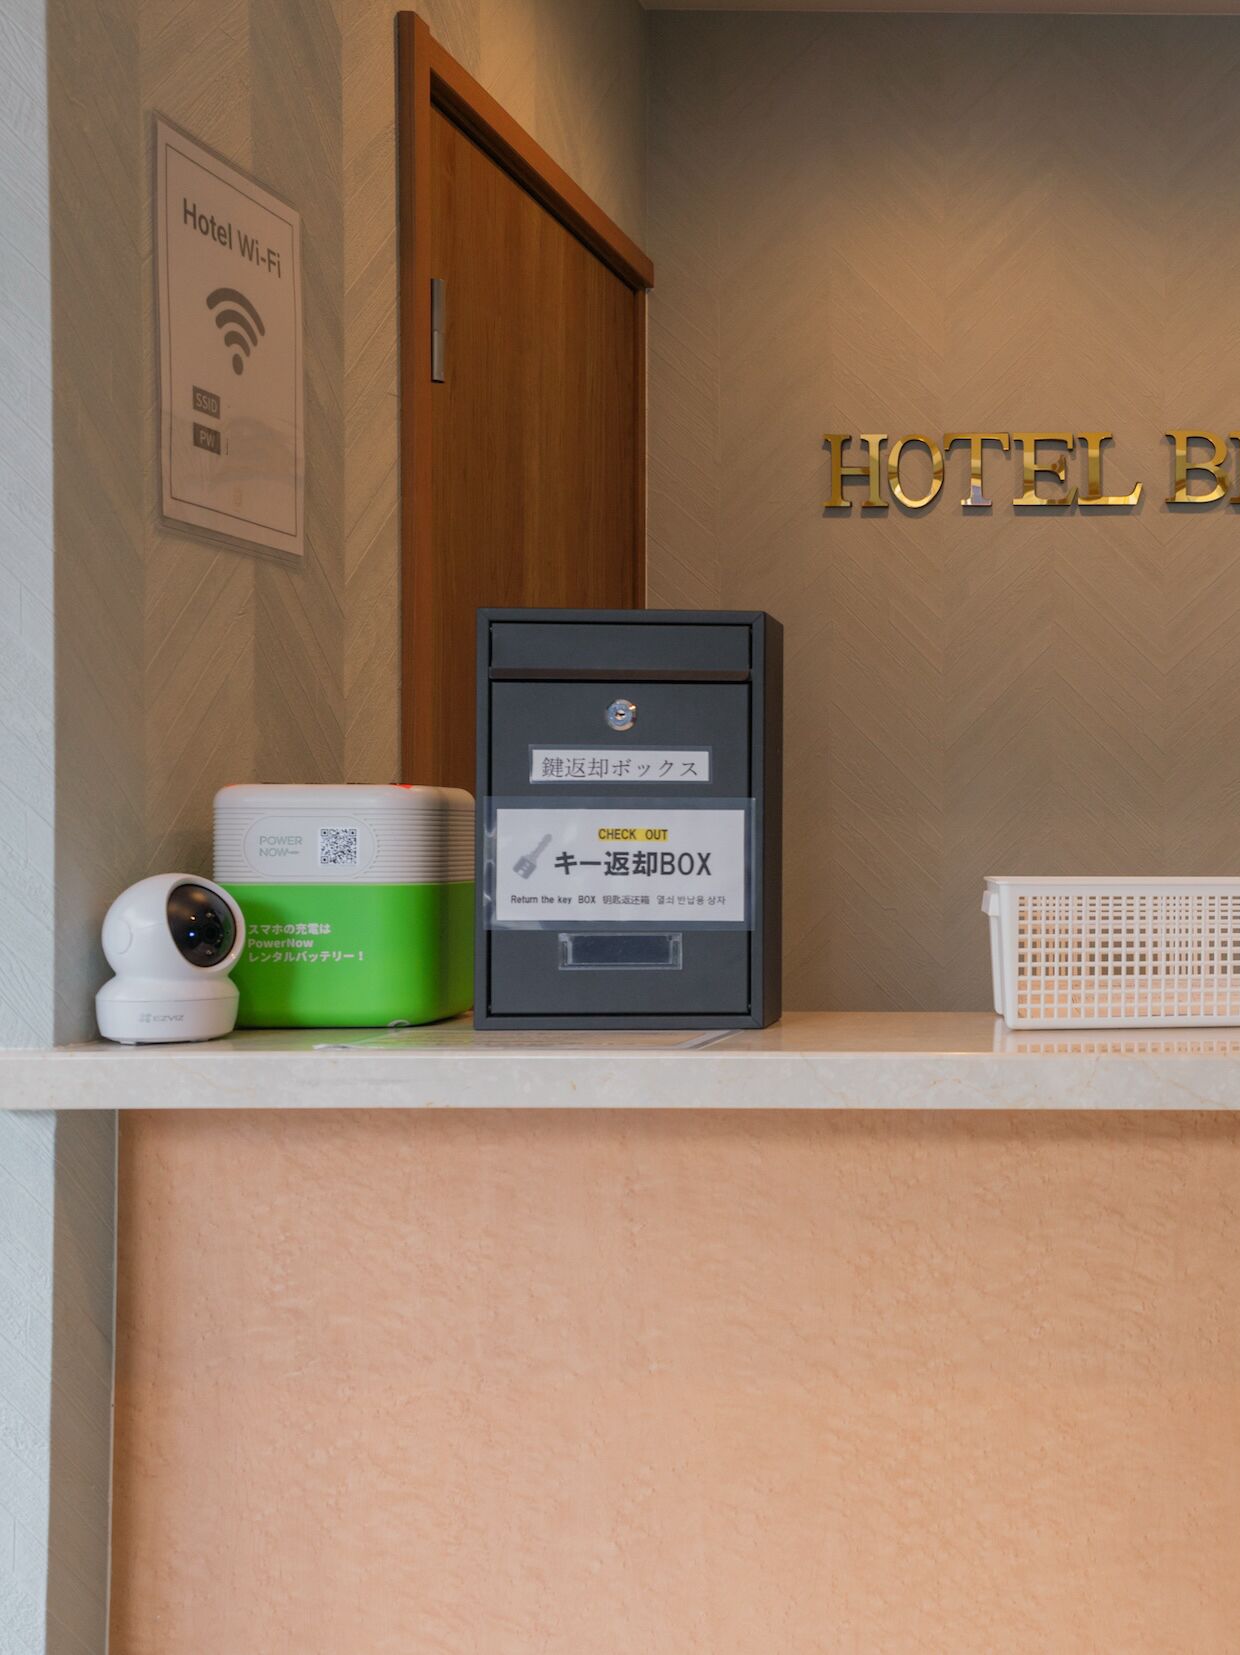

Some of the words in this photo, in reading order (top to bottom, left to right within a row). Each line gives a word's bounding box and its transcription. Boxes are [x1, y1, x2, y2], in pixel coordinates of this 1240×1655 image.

[183, 197, 232, 250] Hotel
[237, 229, 282, 279] Wi-Fi
[196, 391, 218, 415] SSID
[823, 432, 1142, 509] HOTEL
[541, 757, 698, 778] 鍵返却ボックス
[259, 835, 303, 846] POWER
[598, 828, 636, 840] CHECK
[645, 829, 668, 840] OUT
[554, 851, 712, 877] キー返却BOX
[248, 923, 331, 935] スマホの充電は
[248, 937, 313, 948] PowerNow
